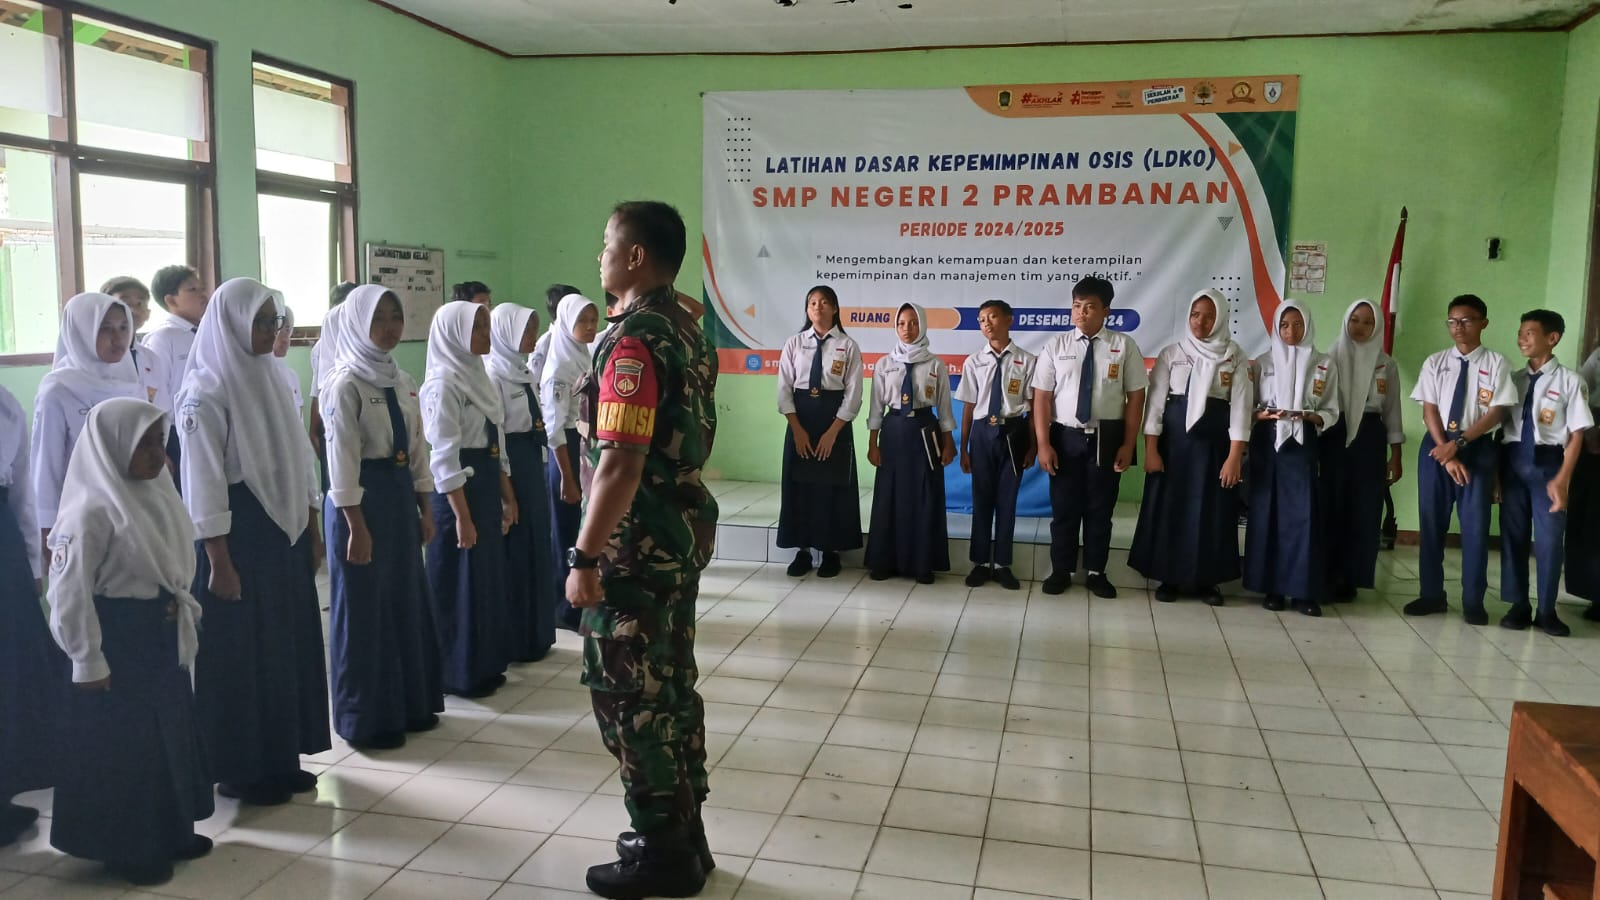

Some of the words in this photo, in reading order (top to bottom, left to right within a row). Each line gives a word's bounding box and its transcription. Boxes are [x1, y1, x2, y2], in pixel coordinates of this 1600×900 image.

[766, 156, 847, 174] LATIHAN
[855, 155, 919, 173] DASAR
[928, 152, 1079, 172] KEPEMIMPINAN
[1088, 151, 1133, 169] OSIS
[1143, 147, 1216, 171] (LDKO)
[752, 186, 817, 208] SMP
[831, 186, 948, 207] NEGERI
[962, 184, 978, 206] 2
[993, 181, 1228, 206] PRAMBANAN
[899, 222, 967, 237] PERIODE
[974, 220, 1064, 237] 2024/2025
[825, 255, 933, 266] Mengembangkan
[937, 255, 1018, 266] kemampuan
[1022, 255, 1047, 265] dan
[1052, 255, 1142, 267] keterampilan
[816, 270, 908, 281] kepemimpinan
[912, 271, 936, 280] dan
[940, 271, 1016, 283] manajemen
[1020, 271, 1043, 281] tim
[1047, 273, 1079, 283] yang
[850, 312, 890, 323] RUANG
[1018, 314, 1075, 326] DESEMB
